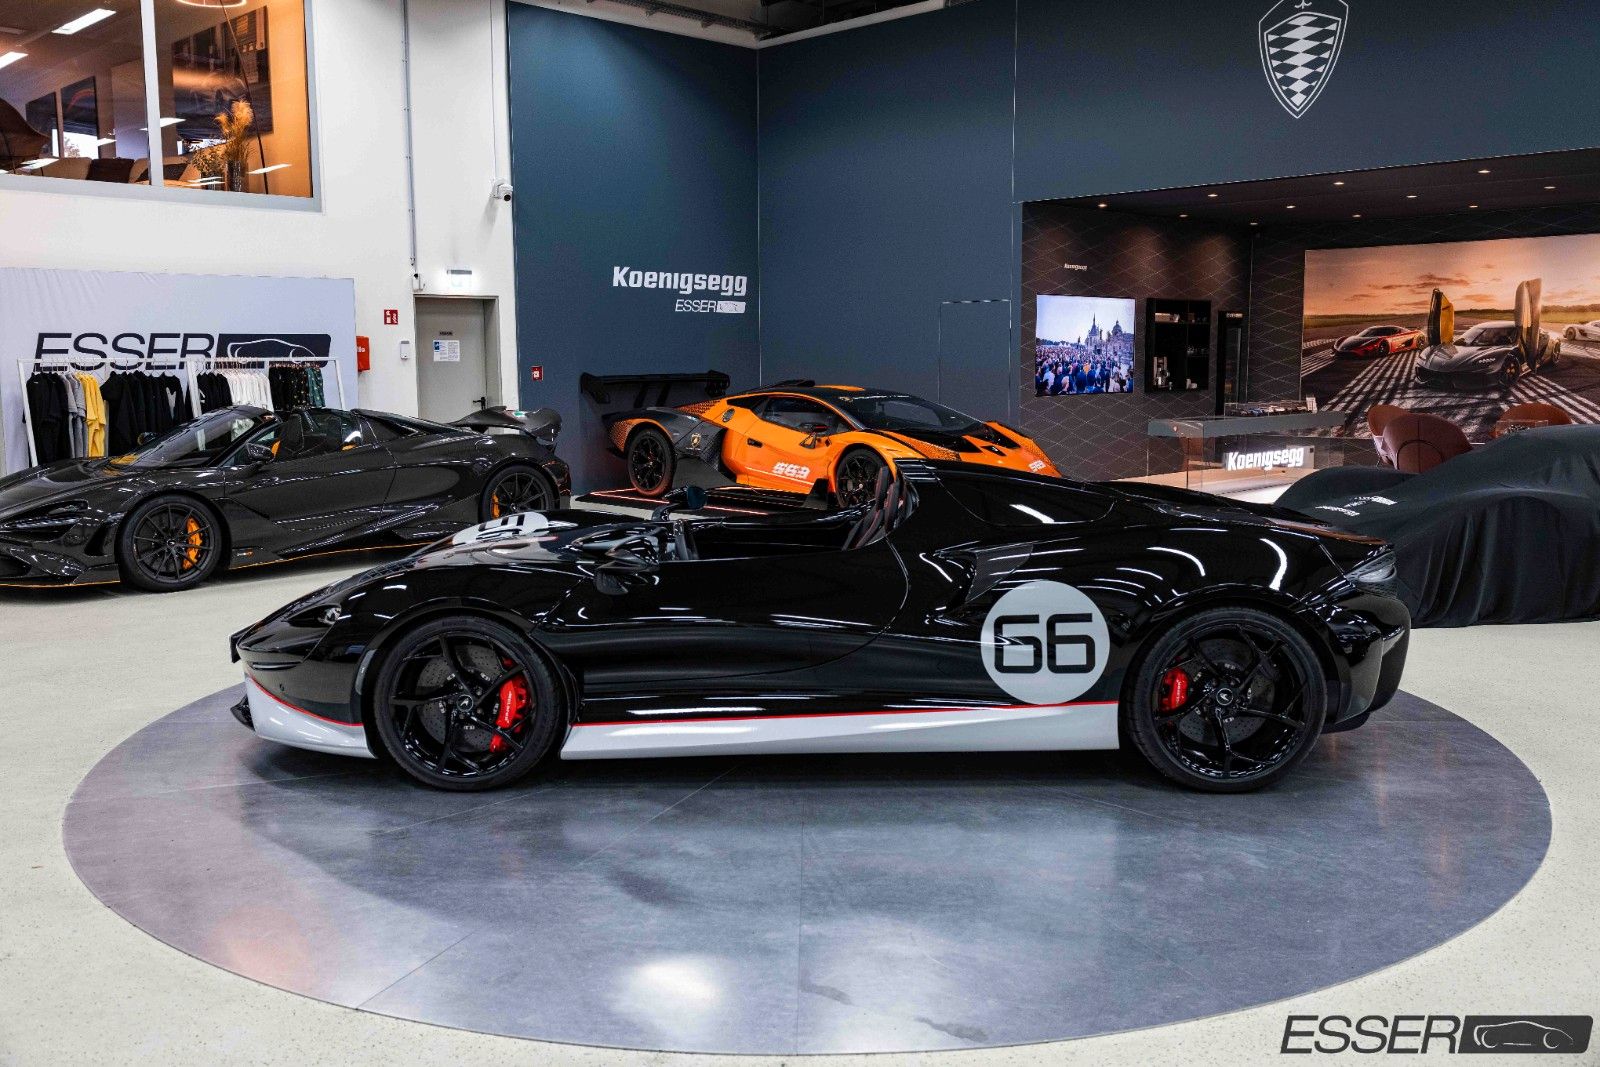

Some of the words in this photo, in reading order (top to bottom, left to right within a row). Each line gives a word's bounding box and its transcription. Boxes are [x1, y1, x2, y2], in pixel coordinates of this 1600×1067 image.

[612, 266, 748, 297] Koenigsegg
[674, 299, 717, 313] ESSER
[33, 332, 215, 373] ESSER
[1226, 447, 1305, 472] Koenigsegg
[993, 612, 1096, 674] 66
